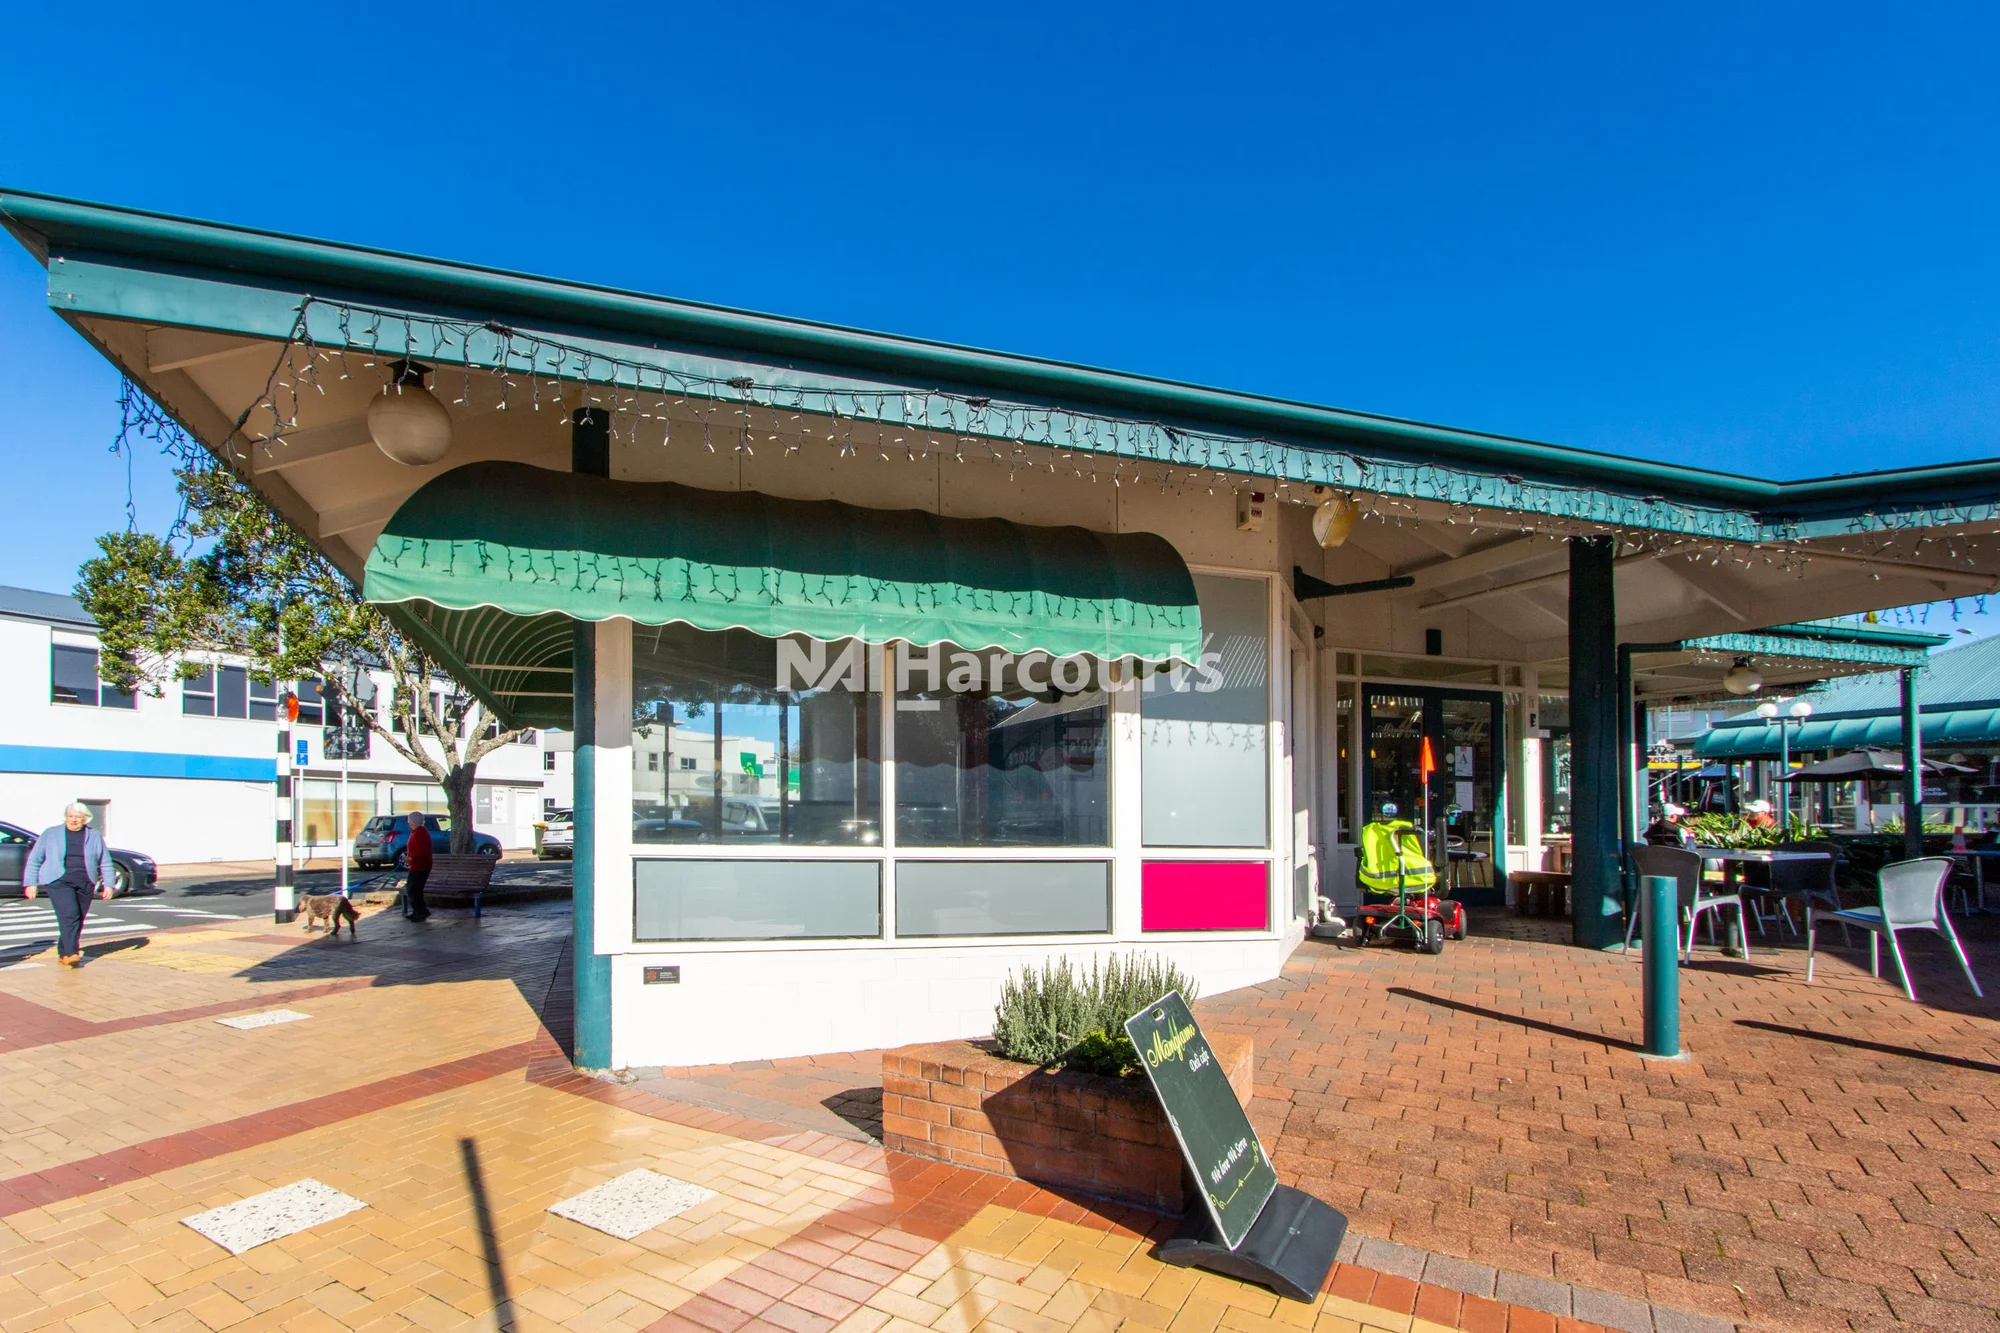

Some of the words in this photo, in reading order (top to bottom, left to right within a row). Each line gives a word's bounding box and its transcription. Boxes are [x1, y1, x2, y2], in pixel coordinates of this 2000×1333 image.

[1459, 753, 1468, 764] A
[1146, 1016, 1196, 1068] Mangiamo
[1210, 1165, 1222, 1185] We
[1227, 1146, 1238, 1163] We
